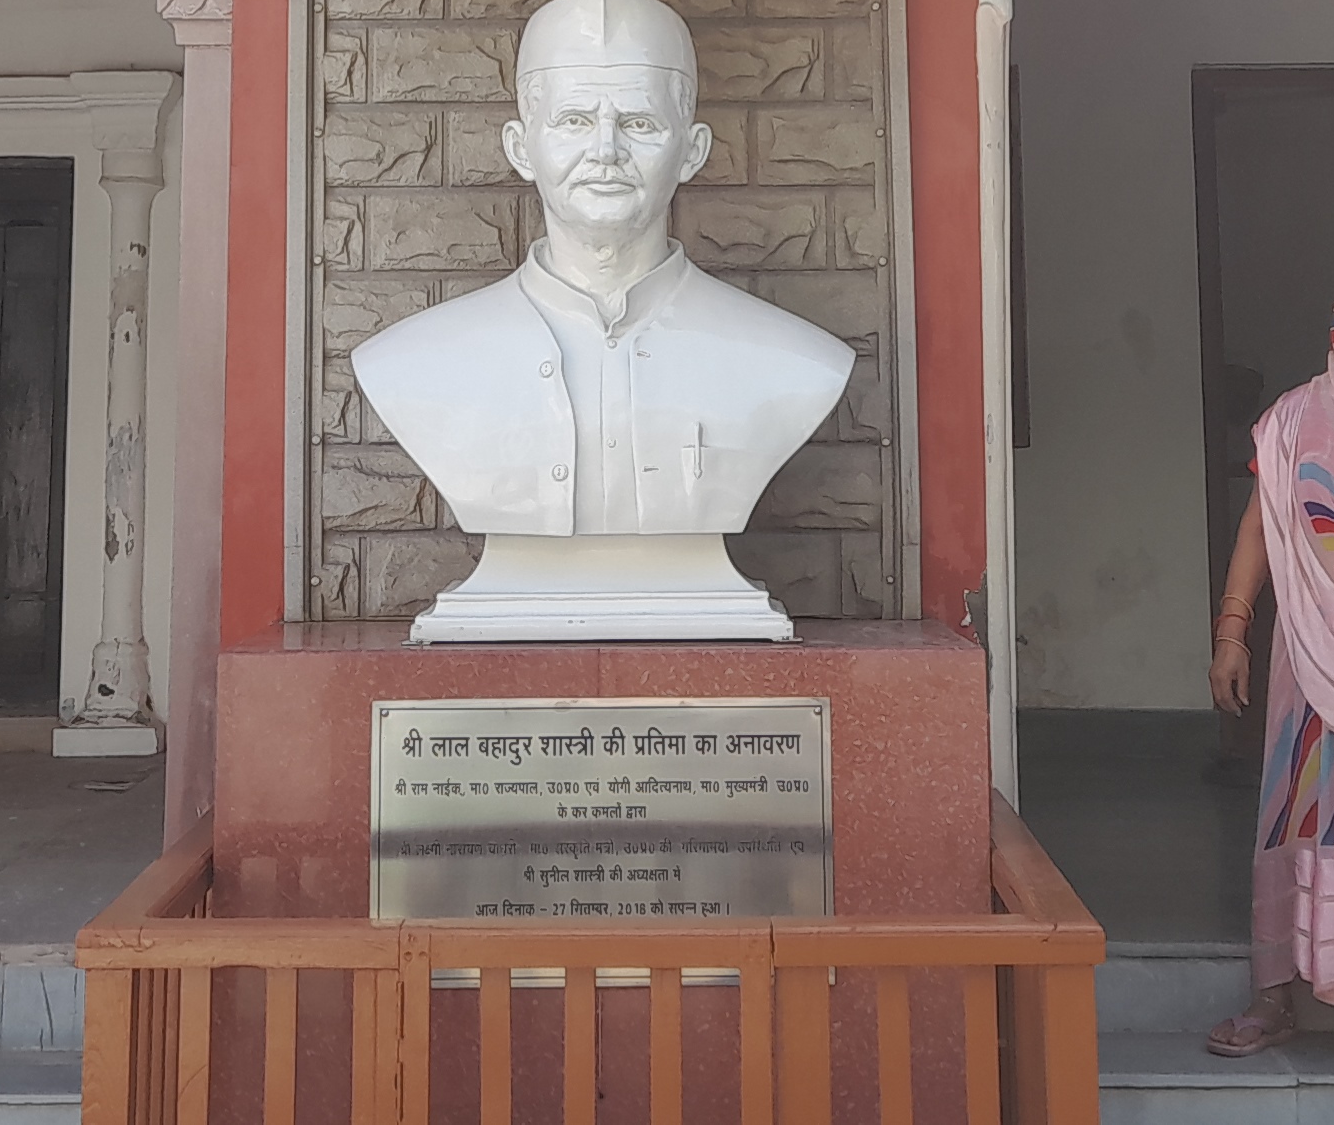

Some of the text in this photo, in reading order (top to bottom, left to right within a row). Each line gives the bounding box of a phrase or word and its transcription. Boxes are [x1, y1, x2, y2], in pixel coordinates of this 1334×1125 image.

[402, 727, 801, 765] श्री लाल बहादुर शास्त्री की प्रतिमा का अनावरण
[395, 779, 406, 795] श्री
[411, 783, 428, 795] राम
[494, 782, 542, 796] राज्यपाल,
[584, 777, 599, 796] एवं
[607, 776, 630, 794] योगी
[635, 777, 696, 795] आदित्यनाथ,
[725, 776, 767, 798] मुख्यमंत्री
[557, 802, 567, 818] के
[571, 807, 587, 818] कर
[626, 806, 646, 819] द्वारा
[540, 865, 569, 887] सुनील
[573, 864, 604, 882] शास्त्री
[609, 865, 622, 881] की
[627, 869, 668, 881] अध्यक्षता
[476, 904, 498, 916] आज
[553, 903, 565, 915] 27
[650, 899, 663, 914] को
